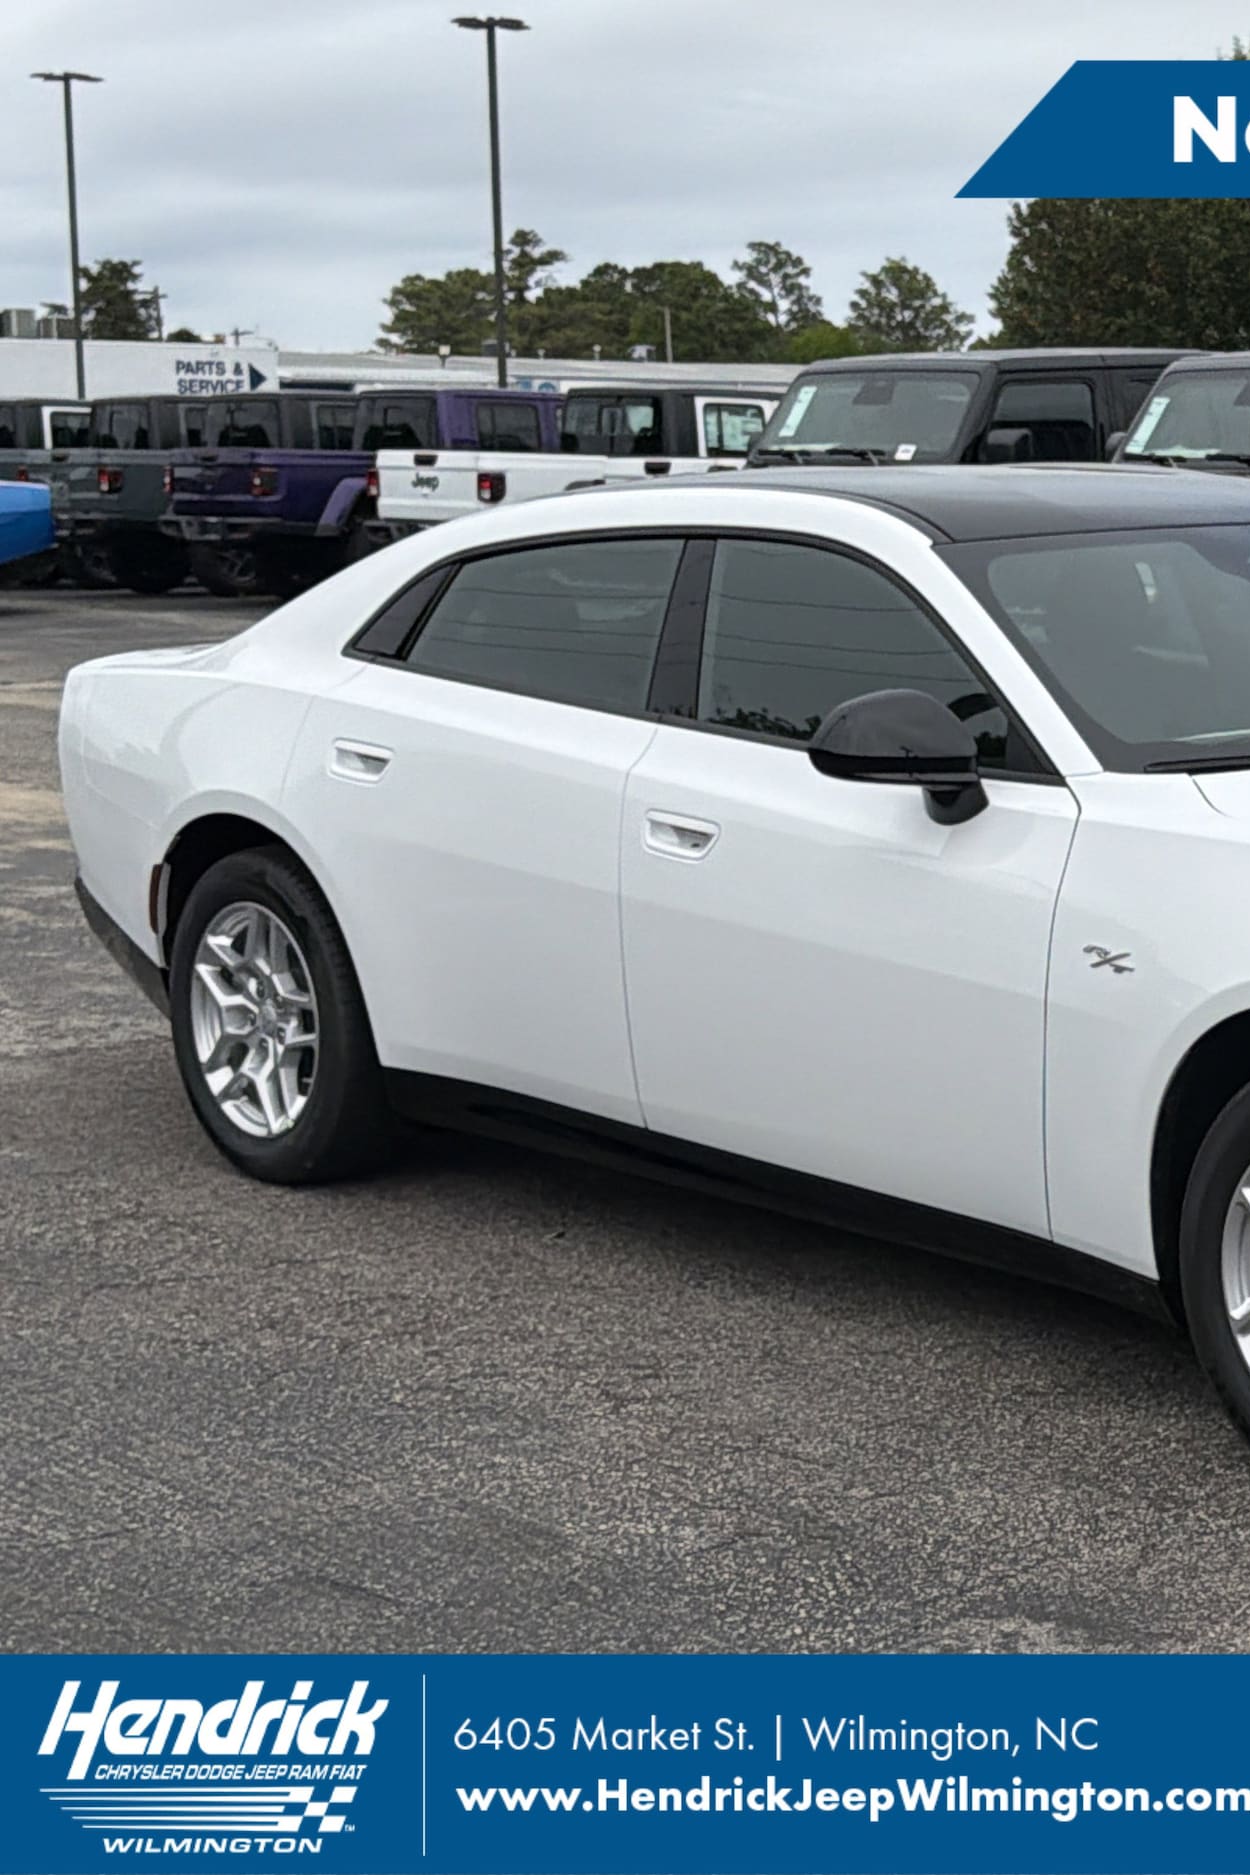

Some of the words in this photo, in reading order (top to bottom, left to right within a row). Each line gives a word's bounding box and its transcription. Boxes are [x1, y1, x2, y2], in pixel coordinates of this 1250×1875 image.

[175, 361, 227, 376] PARTS
[233, 361, 244, 376] &
[177, 379, 244, 394] SERVICE
[411, 472, 439, 492] Jeep
